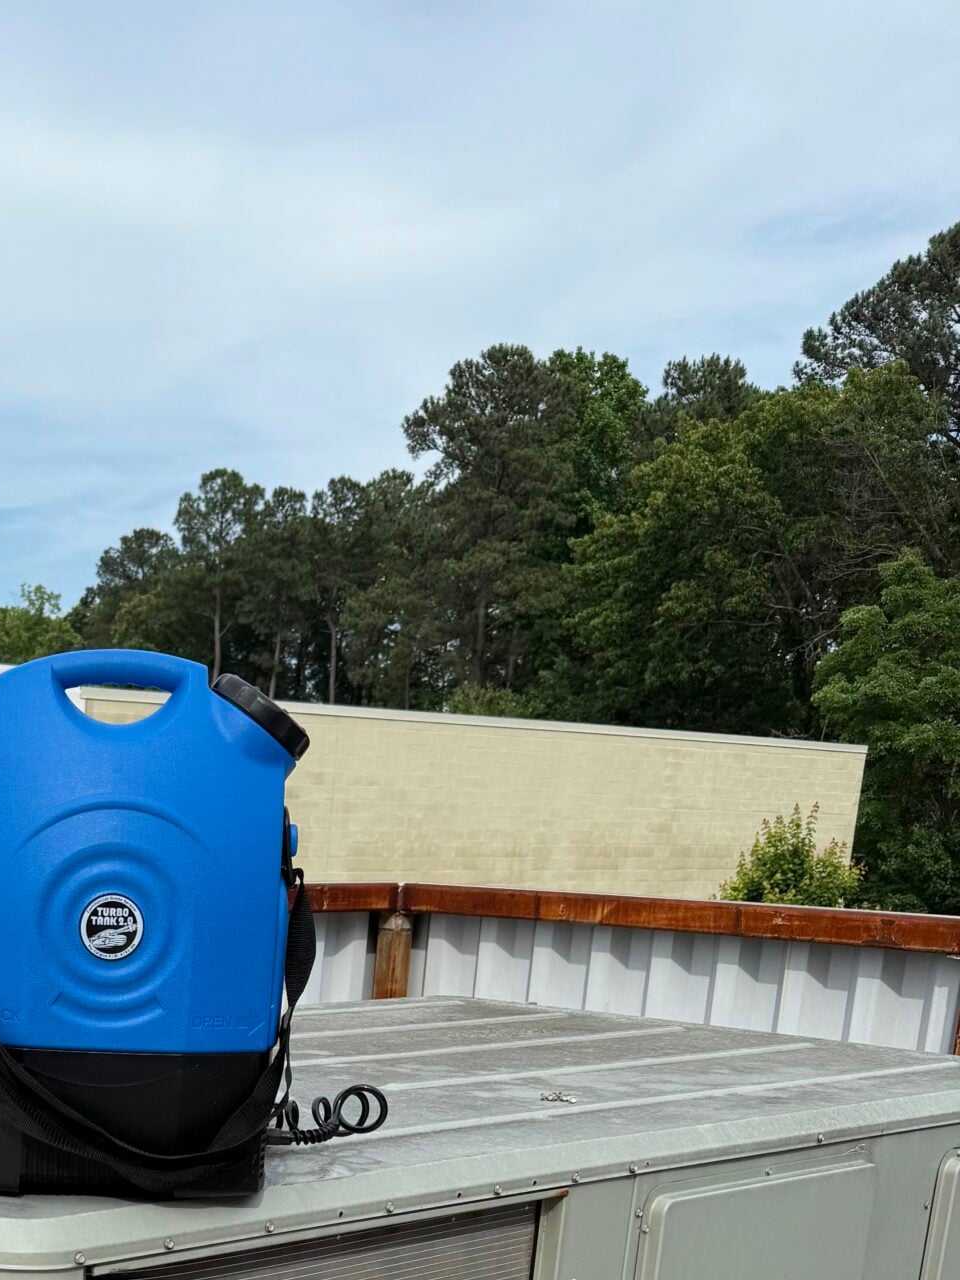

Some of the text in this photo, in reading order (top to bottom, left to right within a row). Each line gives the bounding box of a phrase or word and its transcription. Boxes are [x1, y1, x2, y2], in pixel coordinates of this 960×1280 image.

[97, 907, 129, 917] TURBO
[91, 916, 134, 926] TANK 2.0
